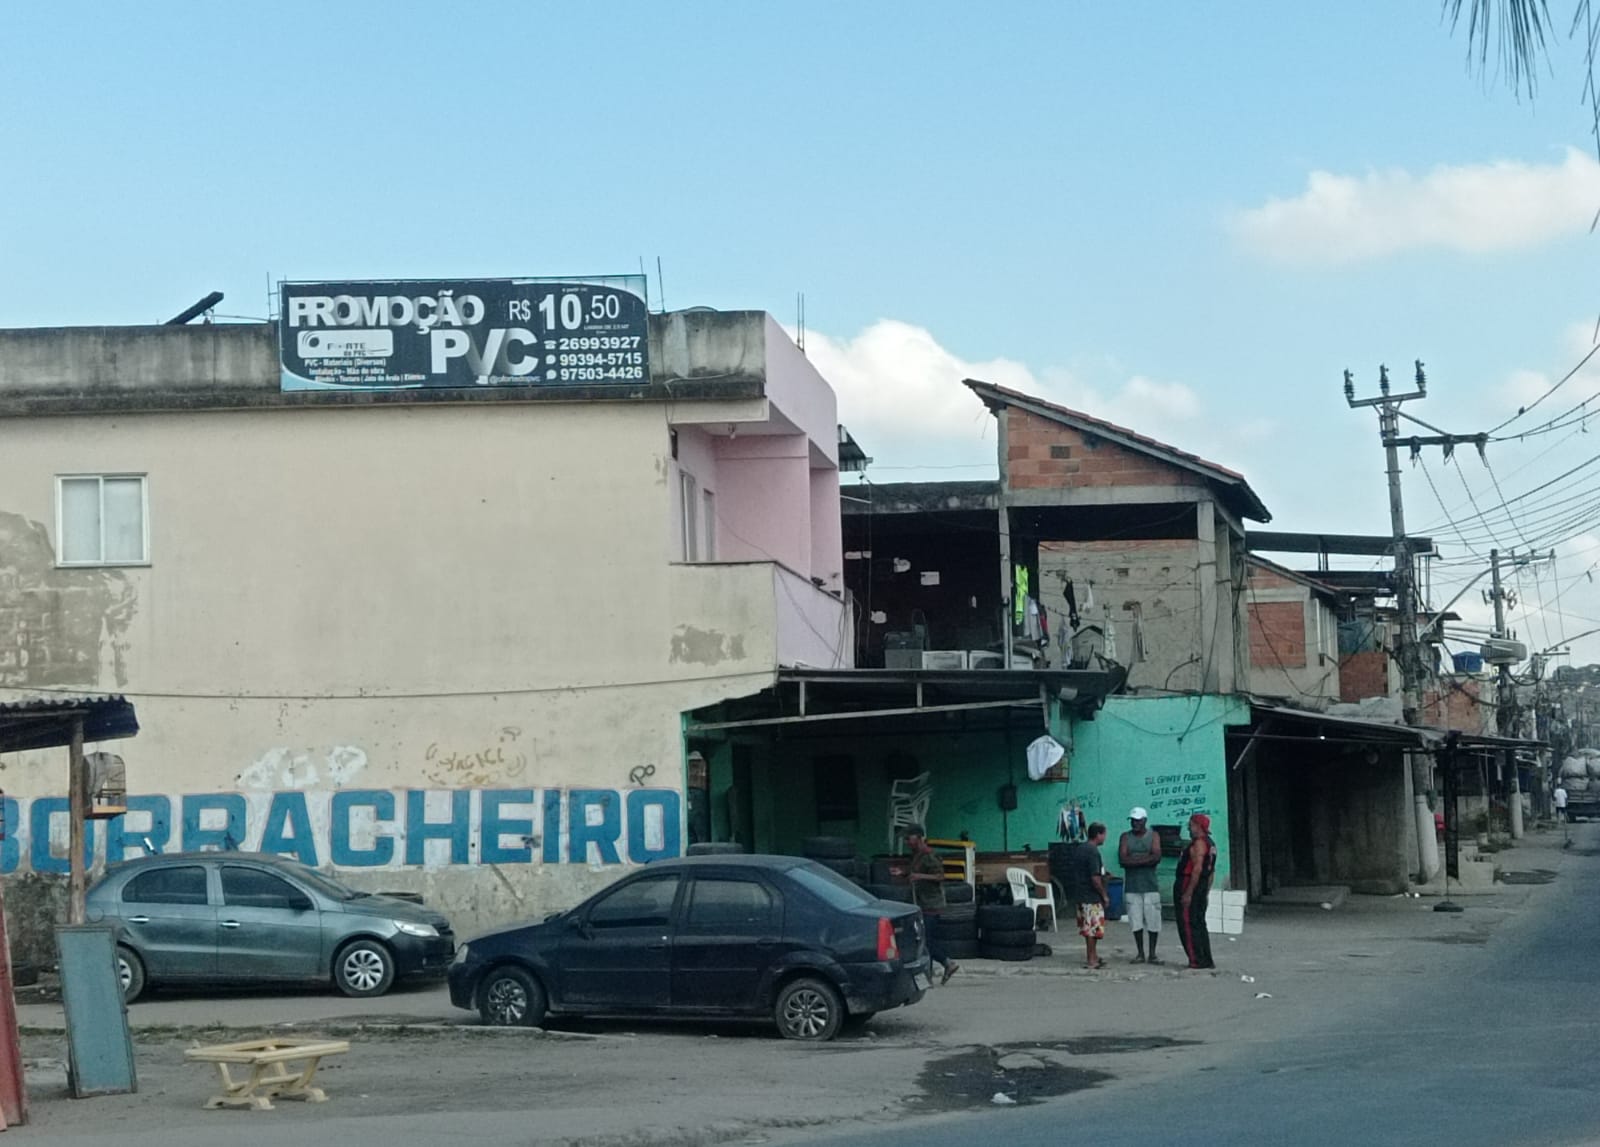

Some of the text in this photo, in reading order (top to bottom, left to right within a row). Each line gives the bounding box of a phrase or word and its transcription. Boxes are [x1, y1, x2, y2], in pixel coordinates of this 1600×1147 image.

[288, 290, 620, 335] PROMOÇÃO R$ 10,50
[431, 328, 539, 376] PVC
[559, 336, 640, 350] 26993927
[560, 352, 642, 366] 99394-5715
[560, 367, 643, 381] 97503-4426
[0, 789, 681, 874] ORRACHEIRO
